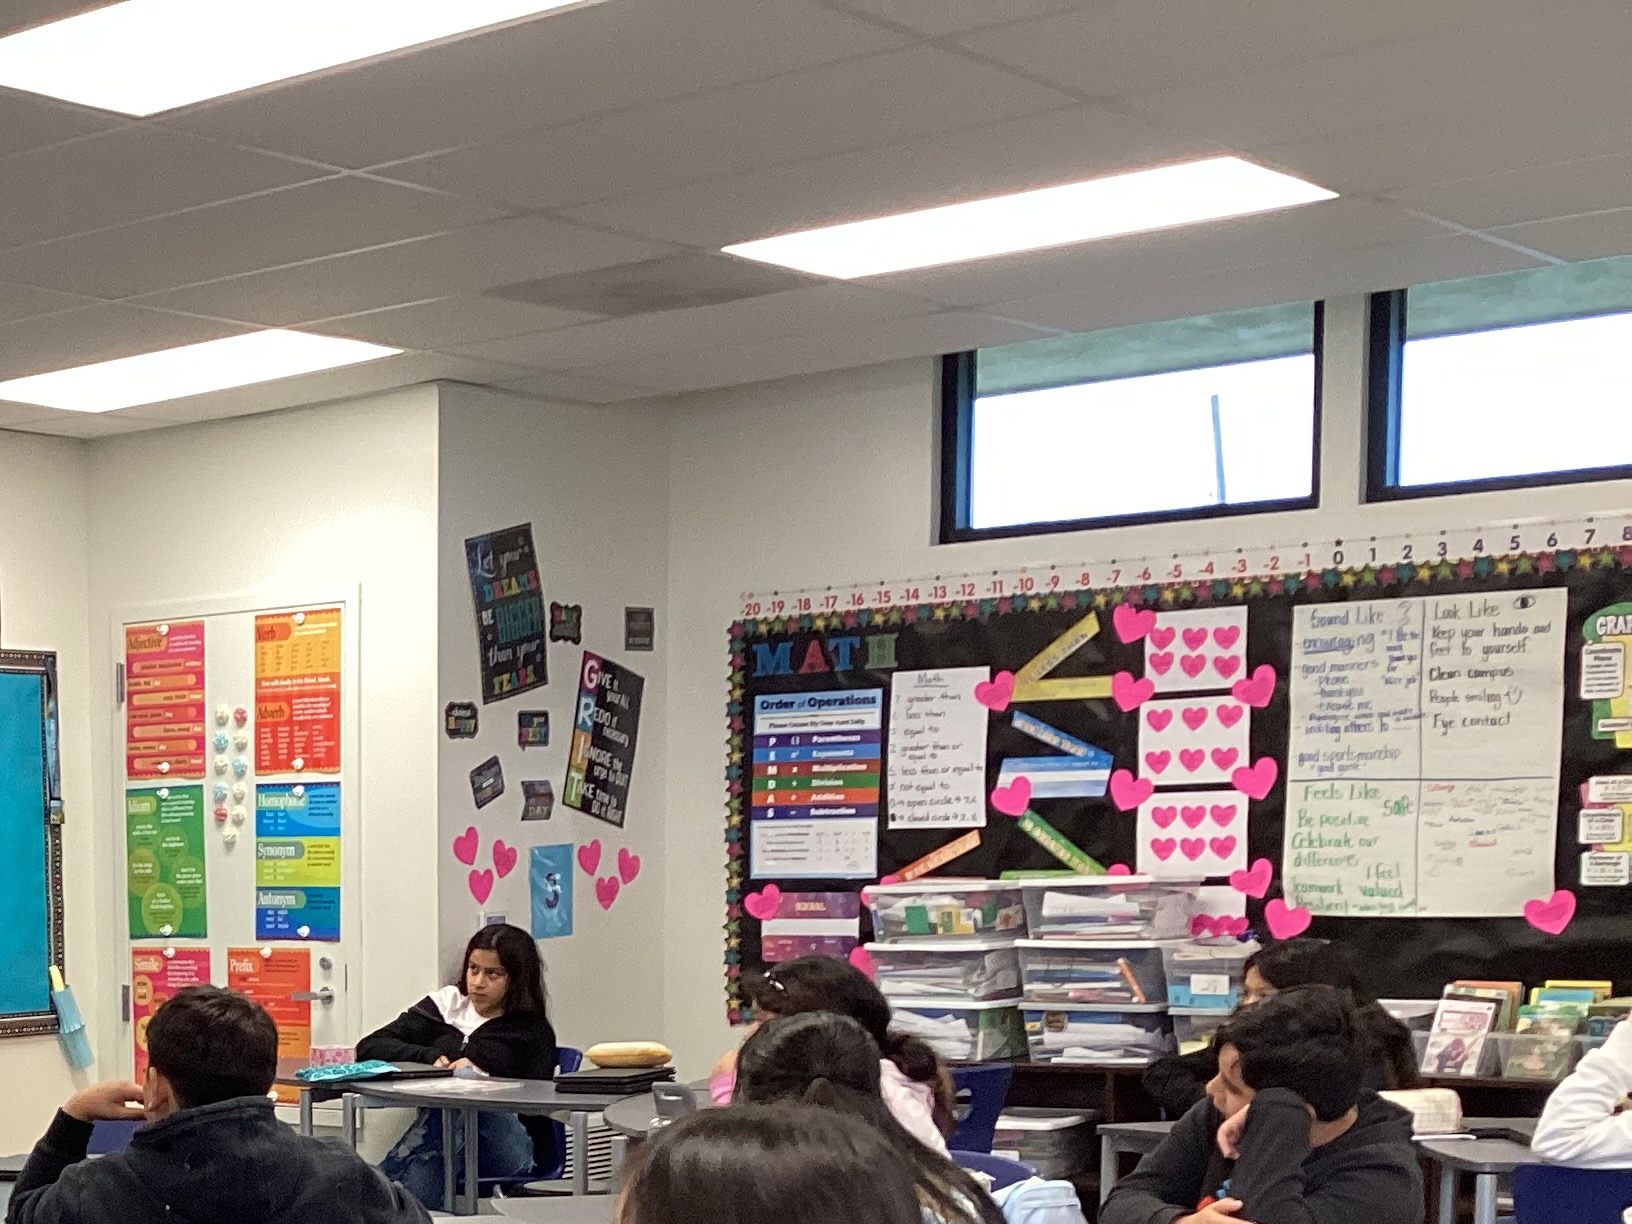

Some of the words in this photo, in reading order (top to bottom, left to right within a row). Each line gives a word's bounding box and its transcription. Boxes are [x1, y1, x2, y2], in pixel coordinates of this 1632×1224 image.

[473, 545, 496, 578] Let
[741, 602, 761, 616] -20
[767, 601, 785, 614] -19
[793, 598, 811, 611] -18
[820, 595, 838, 609] -17
[846, 593, 864, 606] -16
[872, 591, 891, 604] -15
[900, 588, 919, 602] -14
[928, 586, 947, 599] -13
[956, 583, 975, 597] -12
[986, 580, 1004, 594] -11
[1013, 577, 1034, 592] -10
[1045, 575, 1060, 590] -9
[1075, 573, 1090, 586] -8
[1106, 570, 1121, 584] -7
[1136, 567, 1151, 581] -6
[1166, 564, 1183, 579] -5
[1198, 561, 1214, 575] -4
[1231, 559, 1247, 573] -3
[1263, 556, 1280, 570] -2
[1298, 554, 1310, 568] -1
[1333, 550, 1344, 564] 0
[1369, 548, 1377, 562] 1
[1402, 545, 1413, 559] 2
[1437, 542, 1447, 557] 3
[1473, 538, 1484, 553] 4
[1510, 535, 1520, 550] 5
[1547, 532, 1558, 548] 6
[1584, 528, 1596, 544] 7
[484, 569, 538, 603] DREAMS
[1311, 608, 1348, 628] Sound
[1357, 604, 1384, 624] Like
[1434, 602, 1460, 620] Look
[1470, 598, 1500, 619] Like
[1432, 624, 1455, 643] Keep
[1461, 628, 1485, 643] your
[1492, 622, 1528, 637] hands
[128, 634, 164, 652] Adjective
[752, 632, 899, 678] MATH
[493, 664, 538, 695] FEARS
[583, 659, 613, 689] GIVE
[918, 673, 944, 684] Math
[1429, 665, 1462, 682] Clean
[1468, 666, 1514, 681] campus
[257, 704, 285, 720] Adverb
[760, 699, 795, 711] Order
[807, 694, 877, 709] Operations
[1462, 712, 1510, 728] contact
[1304, 782, 1344, 801] Feels
[1350, 782, 1381, 800] Like
[257, 843, 295, 859] Synonym
[257, 890, 296, 907] Antonym
[230, 960, 253, 973] Prefix
